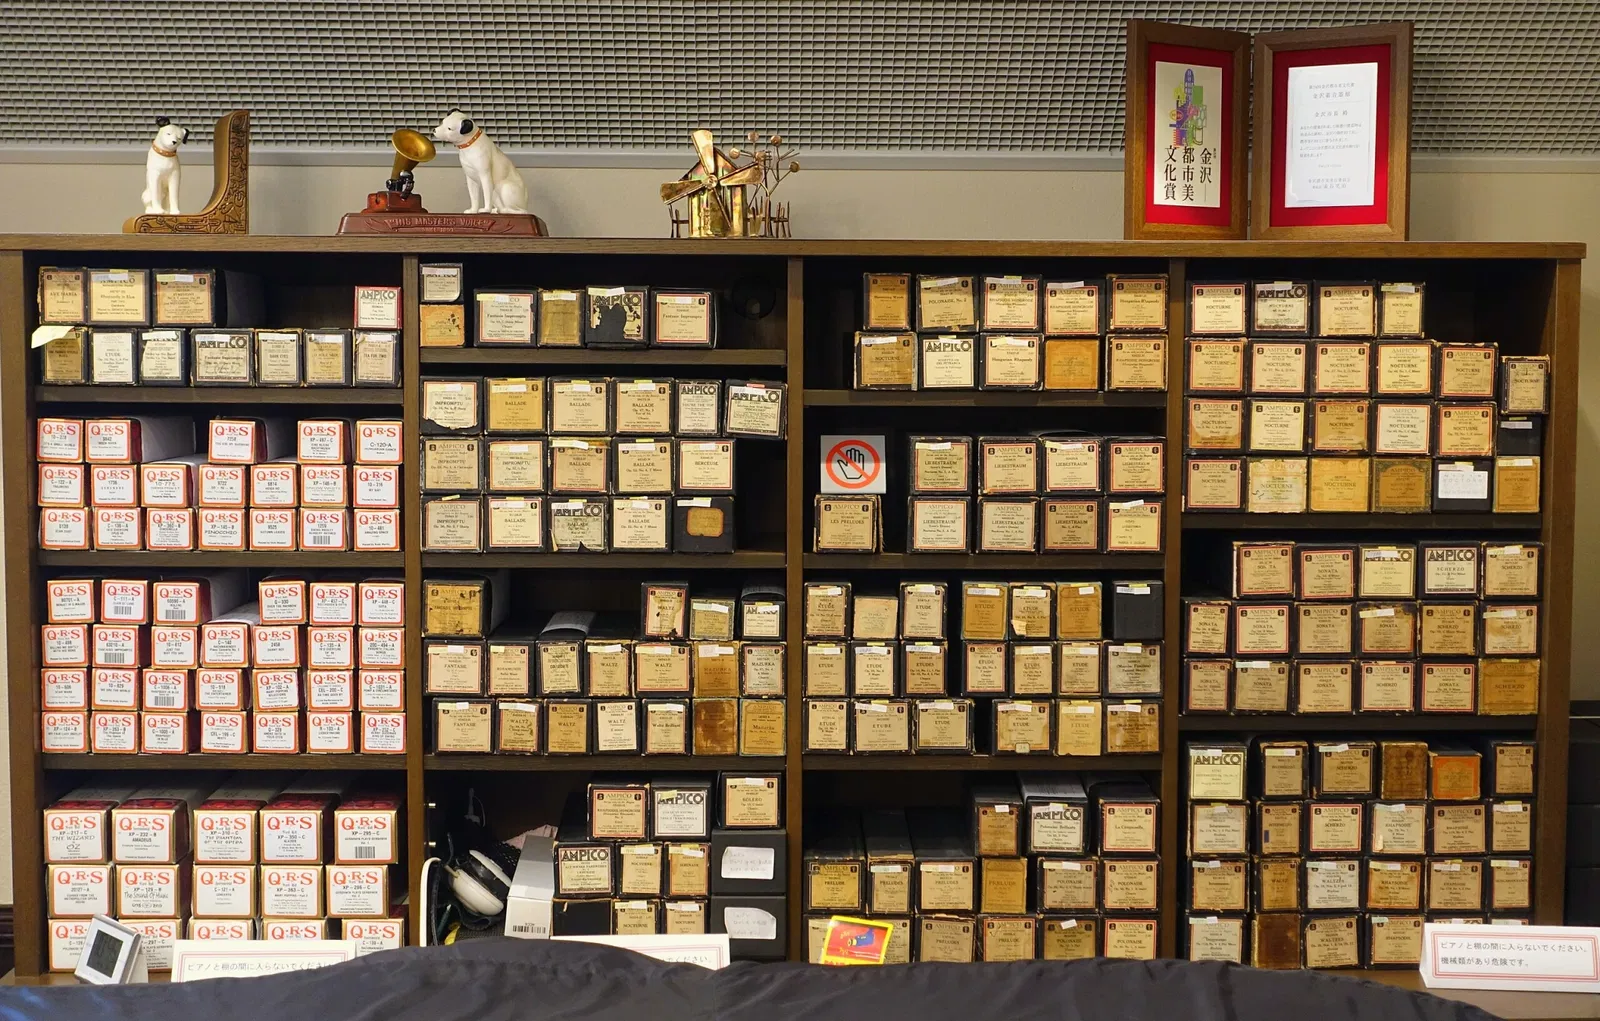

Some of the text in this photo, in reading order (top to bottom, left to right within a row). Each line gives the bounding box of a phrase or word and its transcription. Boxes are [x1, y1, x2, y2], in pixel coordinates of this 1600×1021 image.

[1200, 148, 1212, 183] 金沢
[1164, 145, 1176, 200] 文化賞
[1182, 146, 1194, 202] 都市美
[360, 290, 396, 300] AMPICO
[681, 385, 716, 394] AMPICO
[1428, 550, 1475, 561] AMPICO
[1194, 755, 1241, 765] AMPICO
[561, 849, 608, 861] AMPICO
[1440, 942, 1588, 953] ピアノと棚の間に入らないでください。
[1441, 957, 1529, 967] 機械類があり危険です。
